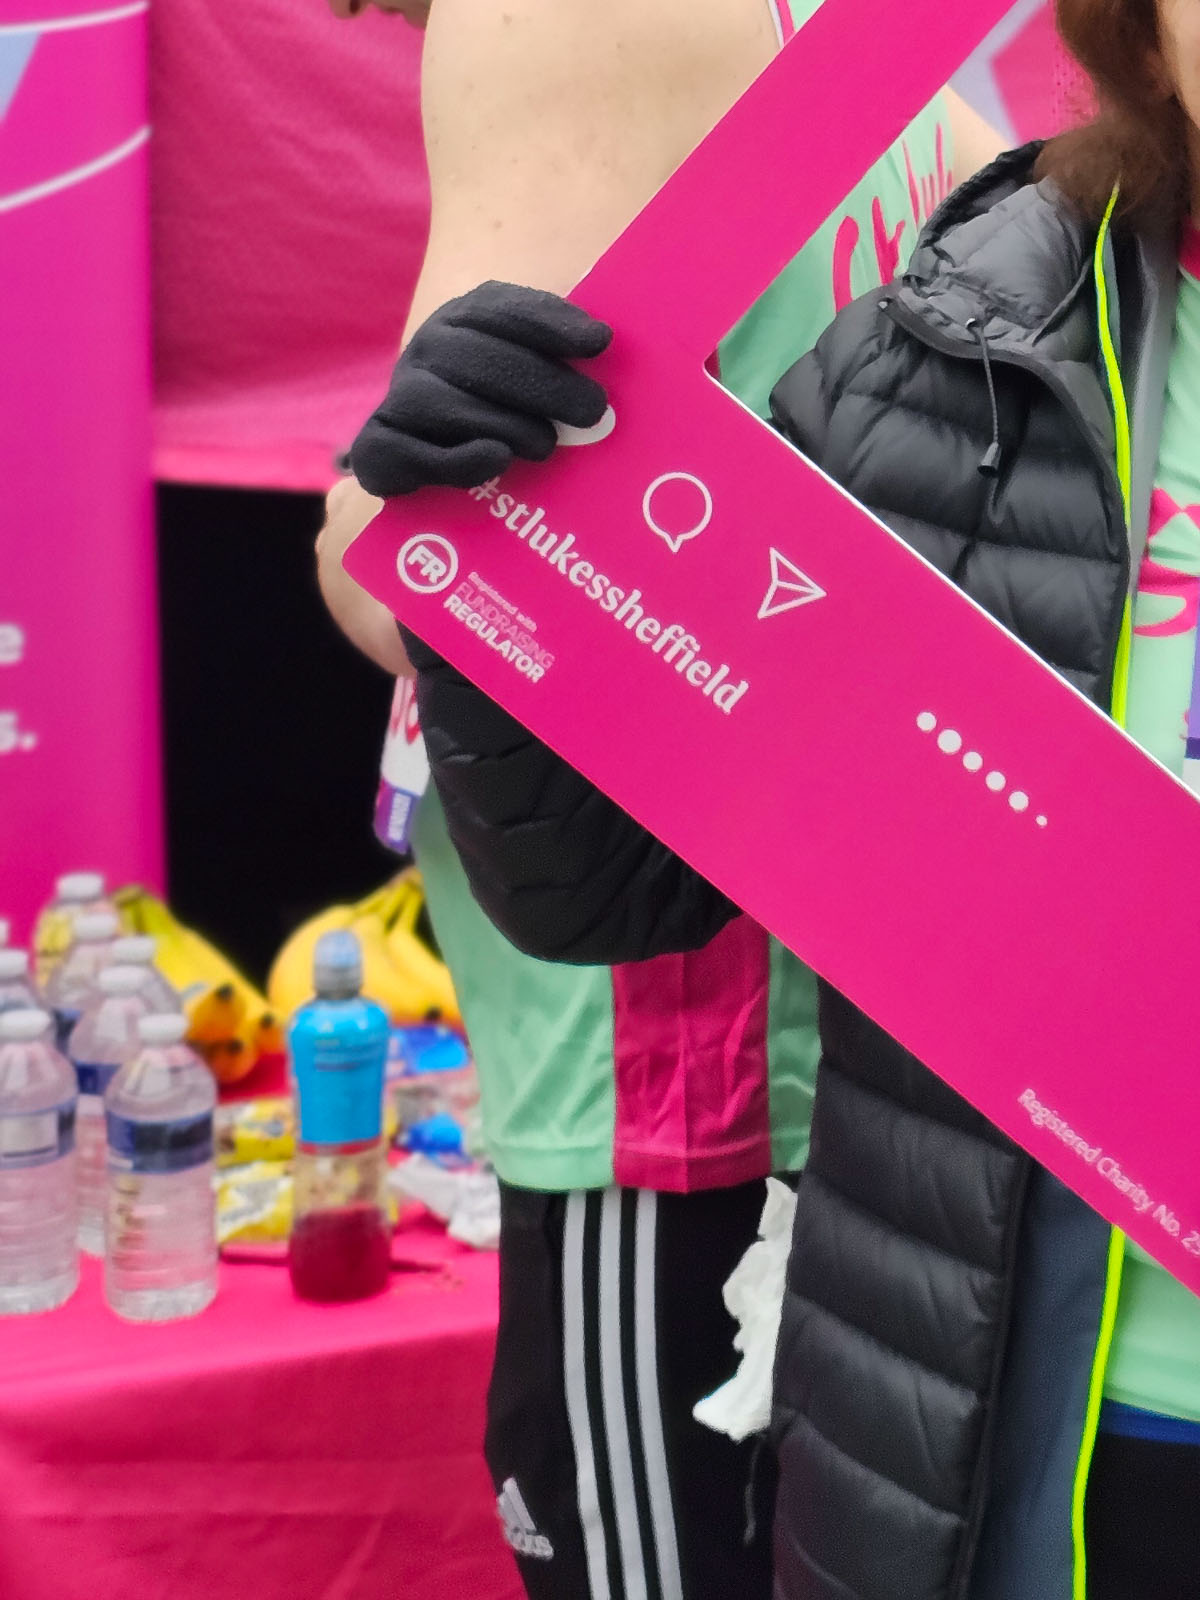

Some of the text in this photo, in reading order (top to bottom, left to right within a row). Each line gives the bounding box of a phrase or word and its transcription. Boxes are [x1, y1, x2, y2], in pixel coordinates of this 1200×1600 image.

[406, 544, 448, 584] FR
[468, 475, 750, 715] #stlukessheffield
[443, 594, 546, 684] REGULATOR
[455, 581, 555, 669] FUNDRAISING
[1018, 1088, 1103, 1163] Registered
[1097, 1157, 1154, 1212] Charity
